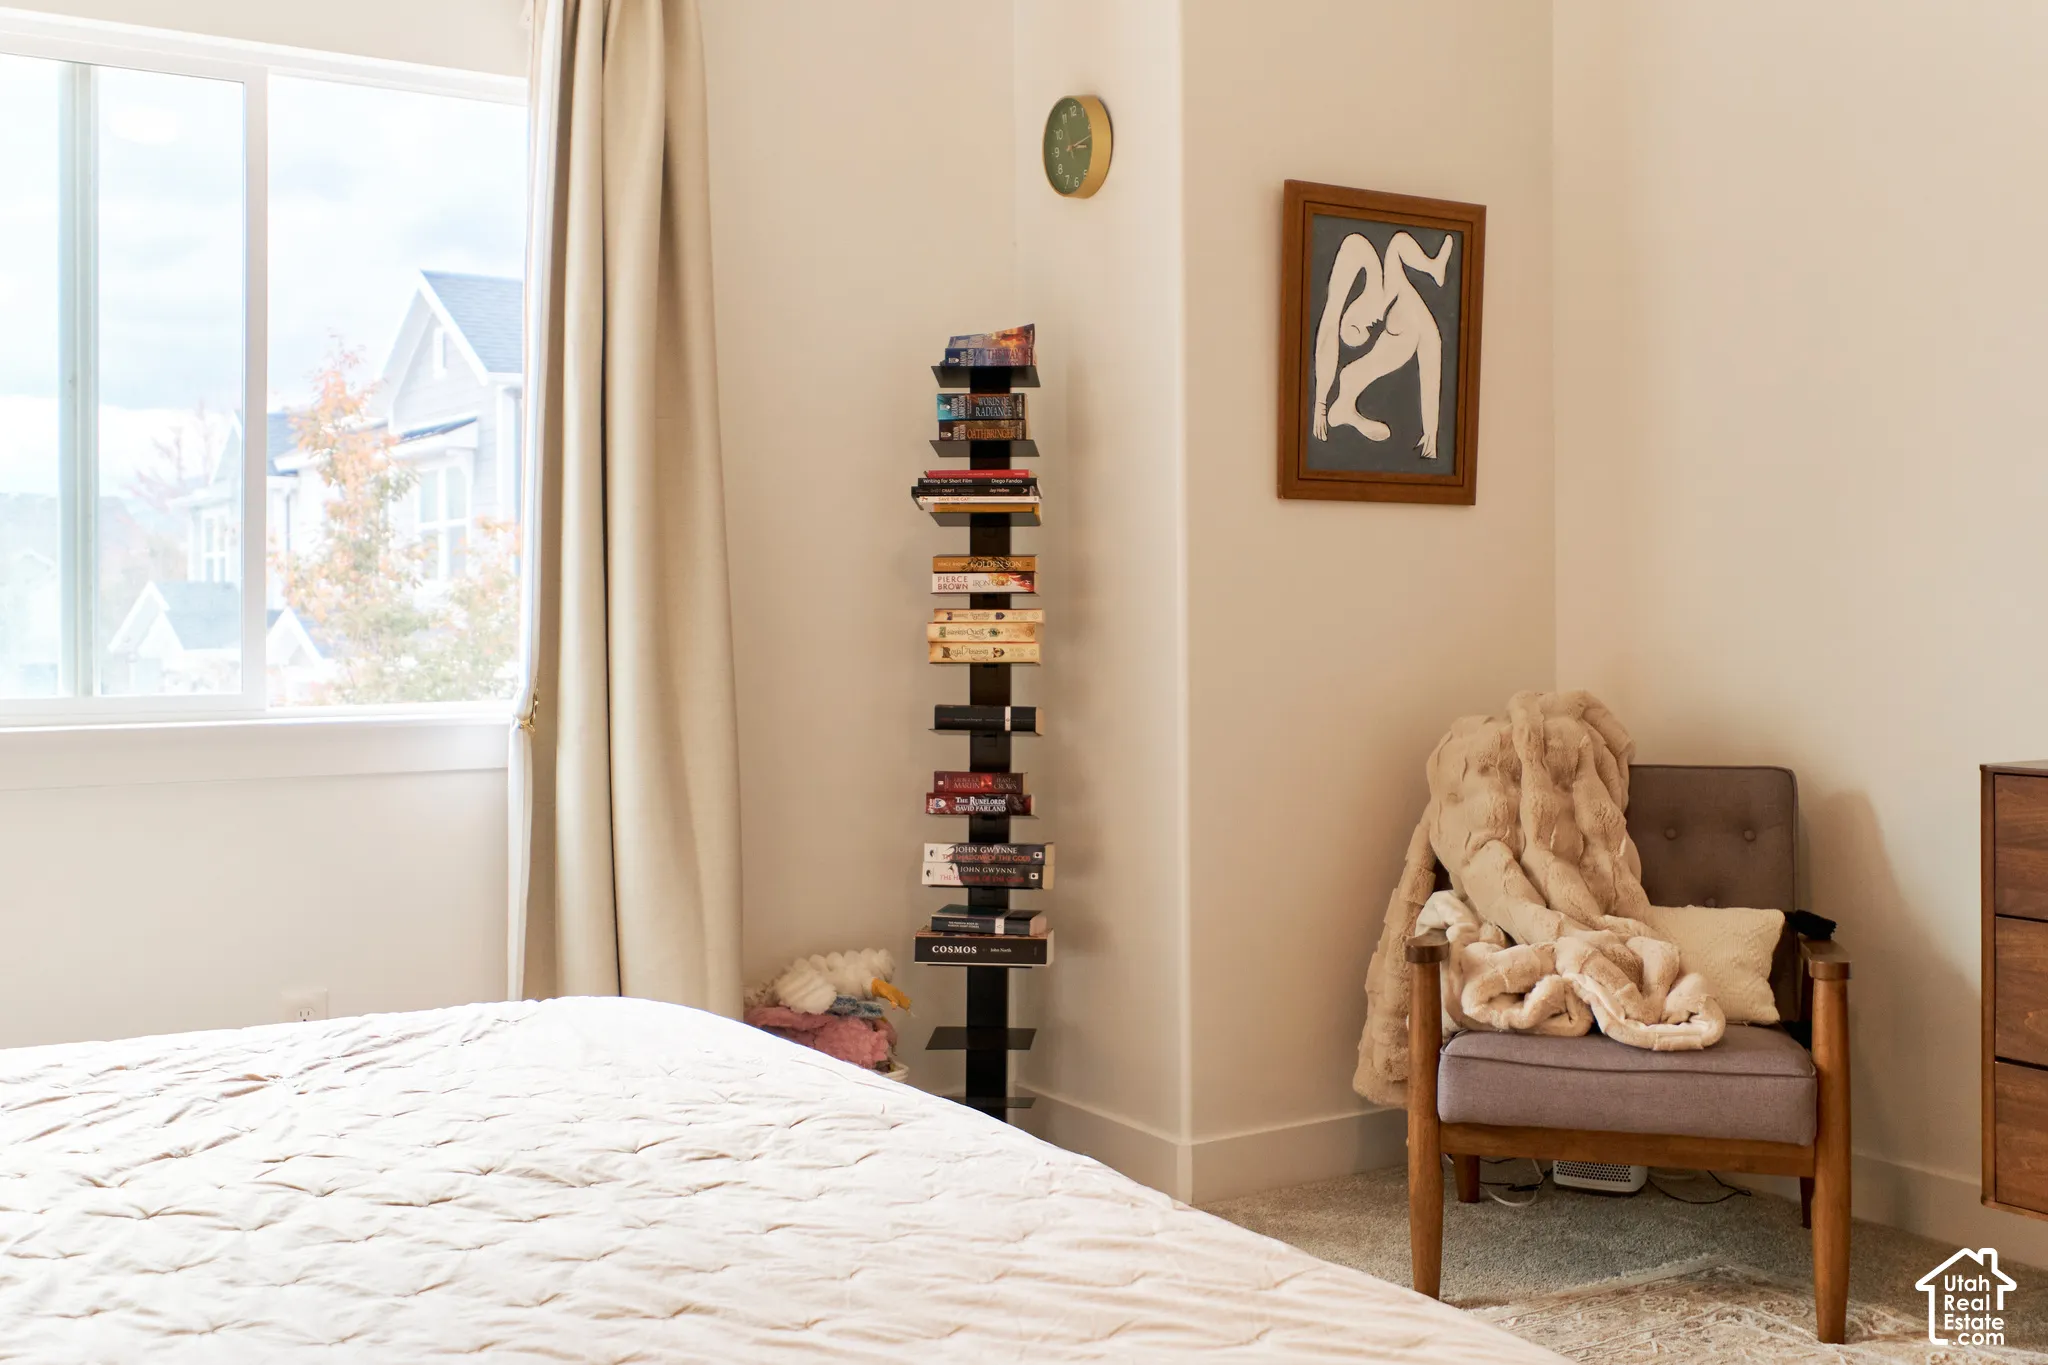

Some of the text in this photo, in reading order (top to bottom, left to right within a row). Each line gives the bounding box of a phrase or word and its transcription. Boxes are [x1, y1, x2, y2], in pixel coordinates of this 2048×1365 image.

[1070, 105, 1076, 117] 12
[1081, 108, 1084, 117] 1
[1062, 114, 1067, 124] 11
[1055, 130, 1063, 140] 10
[1054, 148, 1059, 157] 9
[1058, 164, 1063, 174] 8
[1065, 175, 1069, 185] 7
[1074, 177, 1079, 187] 6
[978, 397, 999, 405] WORDS
[976, 407, 1012, 416] RADIANCE
[967, 428, 1015, 439] OATHBRINGER
[970, 560, 1005, 568] GOLDEN
